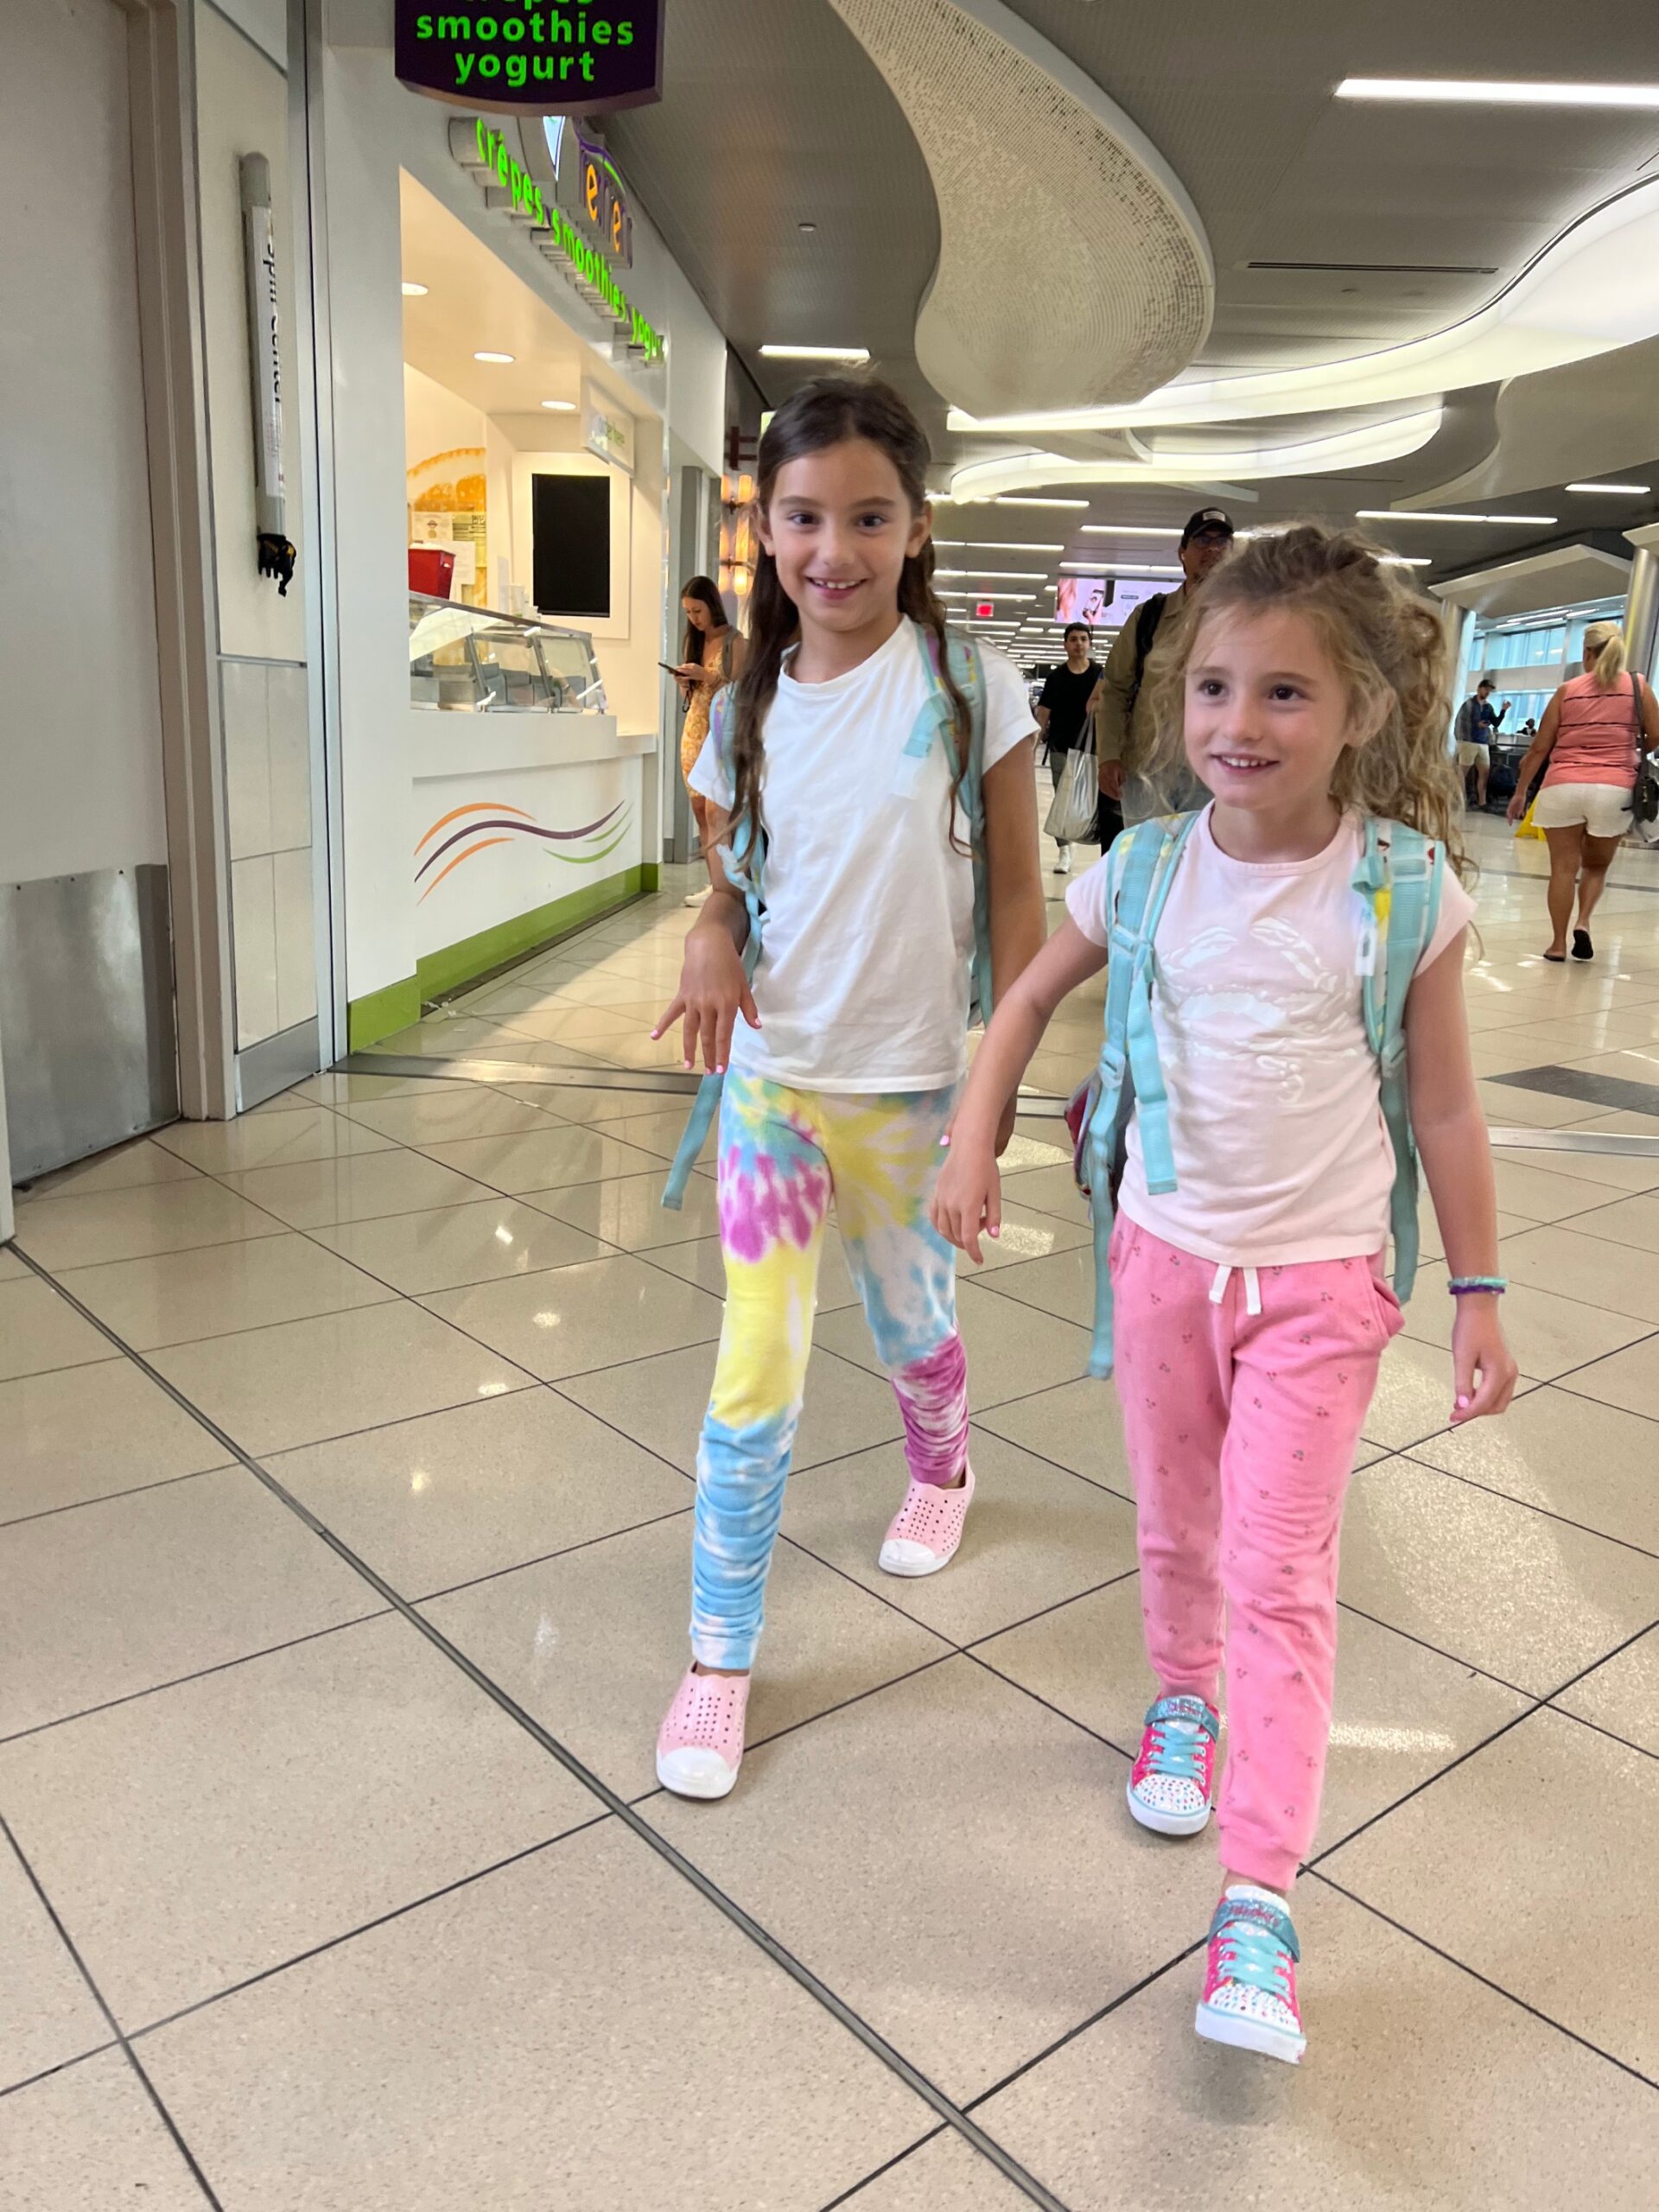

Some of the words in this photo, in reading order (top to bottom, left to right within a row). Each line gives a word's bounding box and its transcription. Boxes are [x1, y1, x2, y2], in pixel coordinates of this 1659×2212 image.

[416, 10, 635, 46] smoothies
[454, 50, 595, 87] yogurt
[551, 208, 628, 322] smoothies
